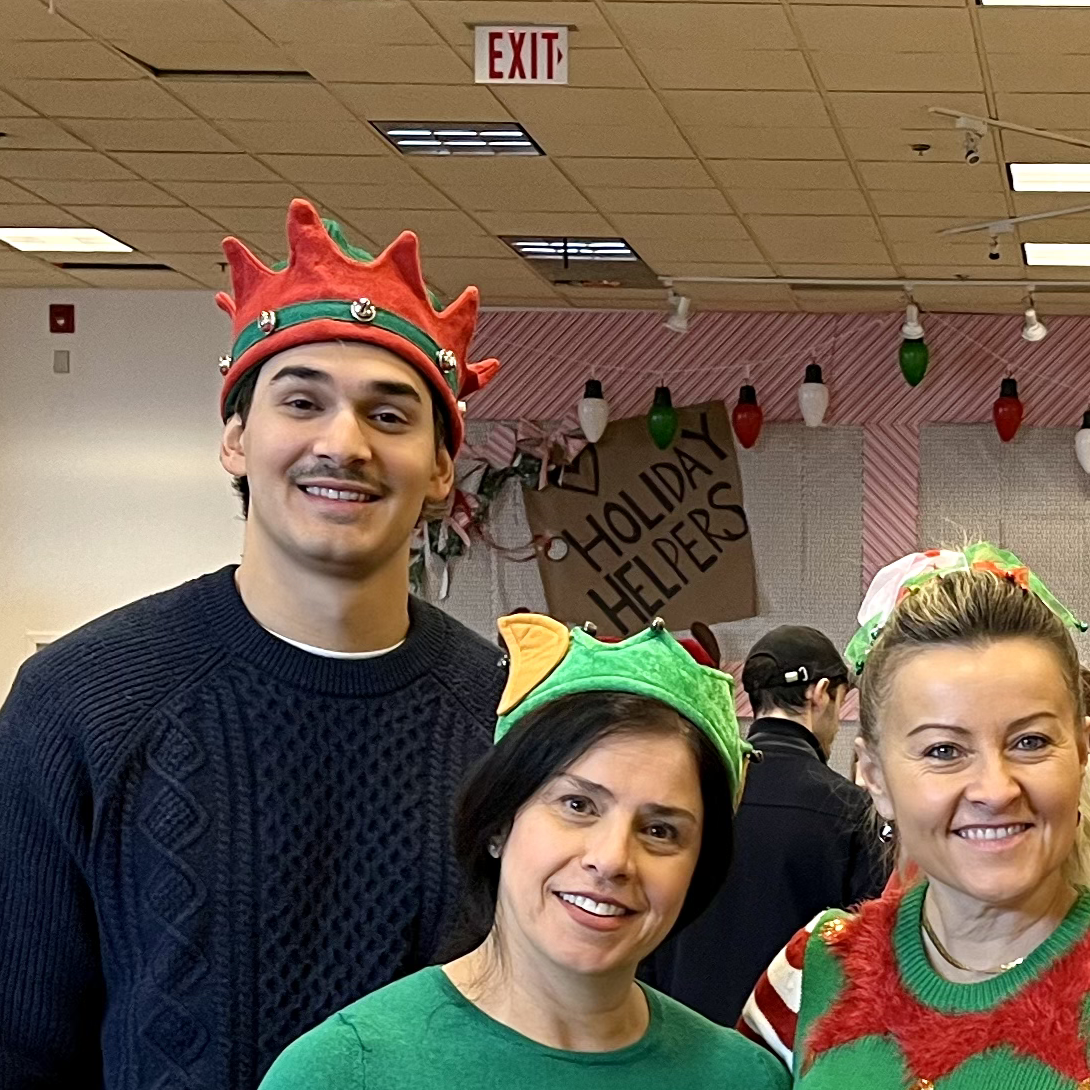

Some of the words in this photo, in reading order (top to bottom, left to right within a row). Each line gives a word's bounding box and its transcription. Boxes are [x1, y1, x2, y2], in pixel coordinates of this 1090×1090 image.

[489, 32, 559, 79] EXIT
[561, 412, 728, 572] HOLIDAY
[586, 481, 749, 636] HELPERS
